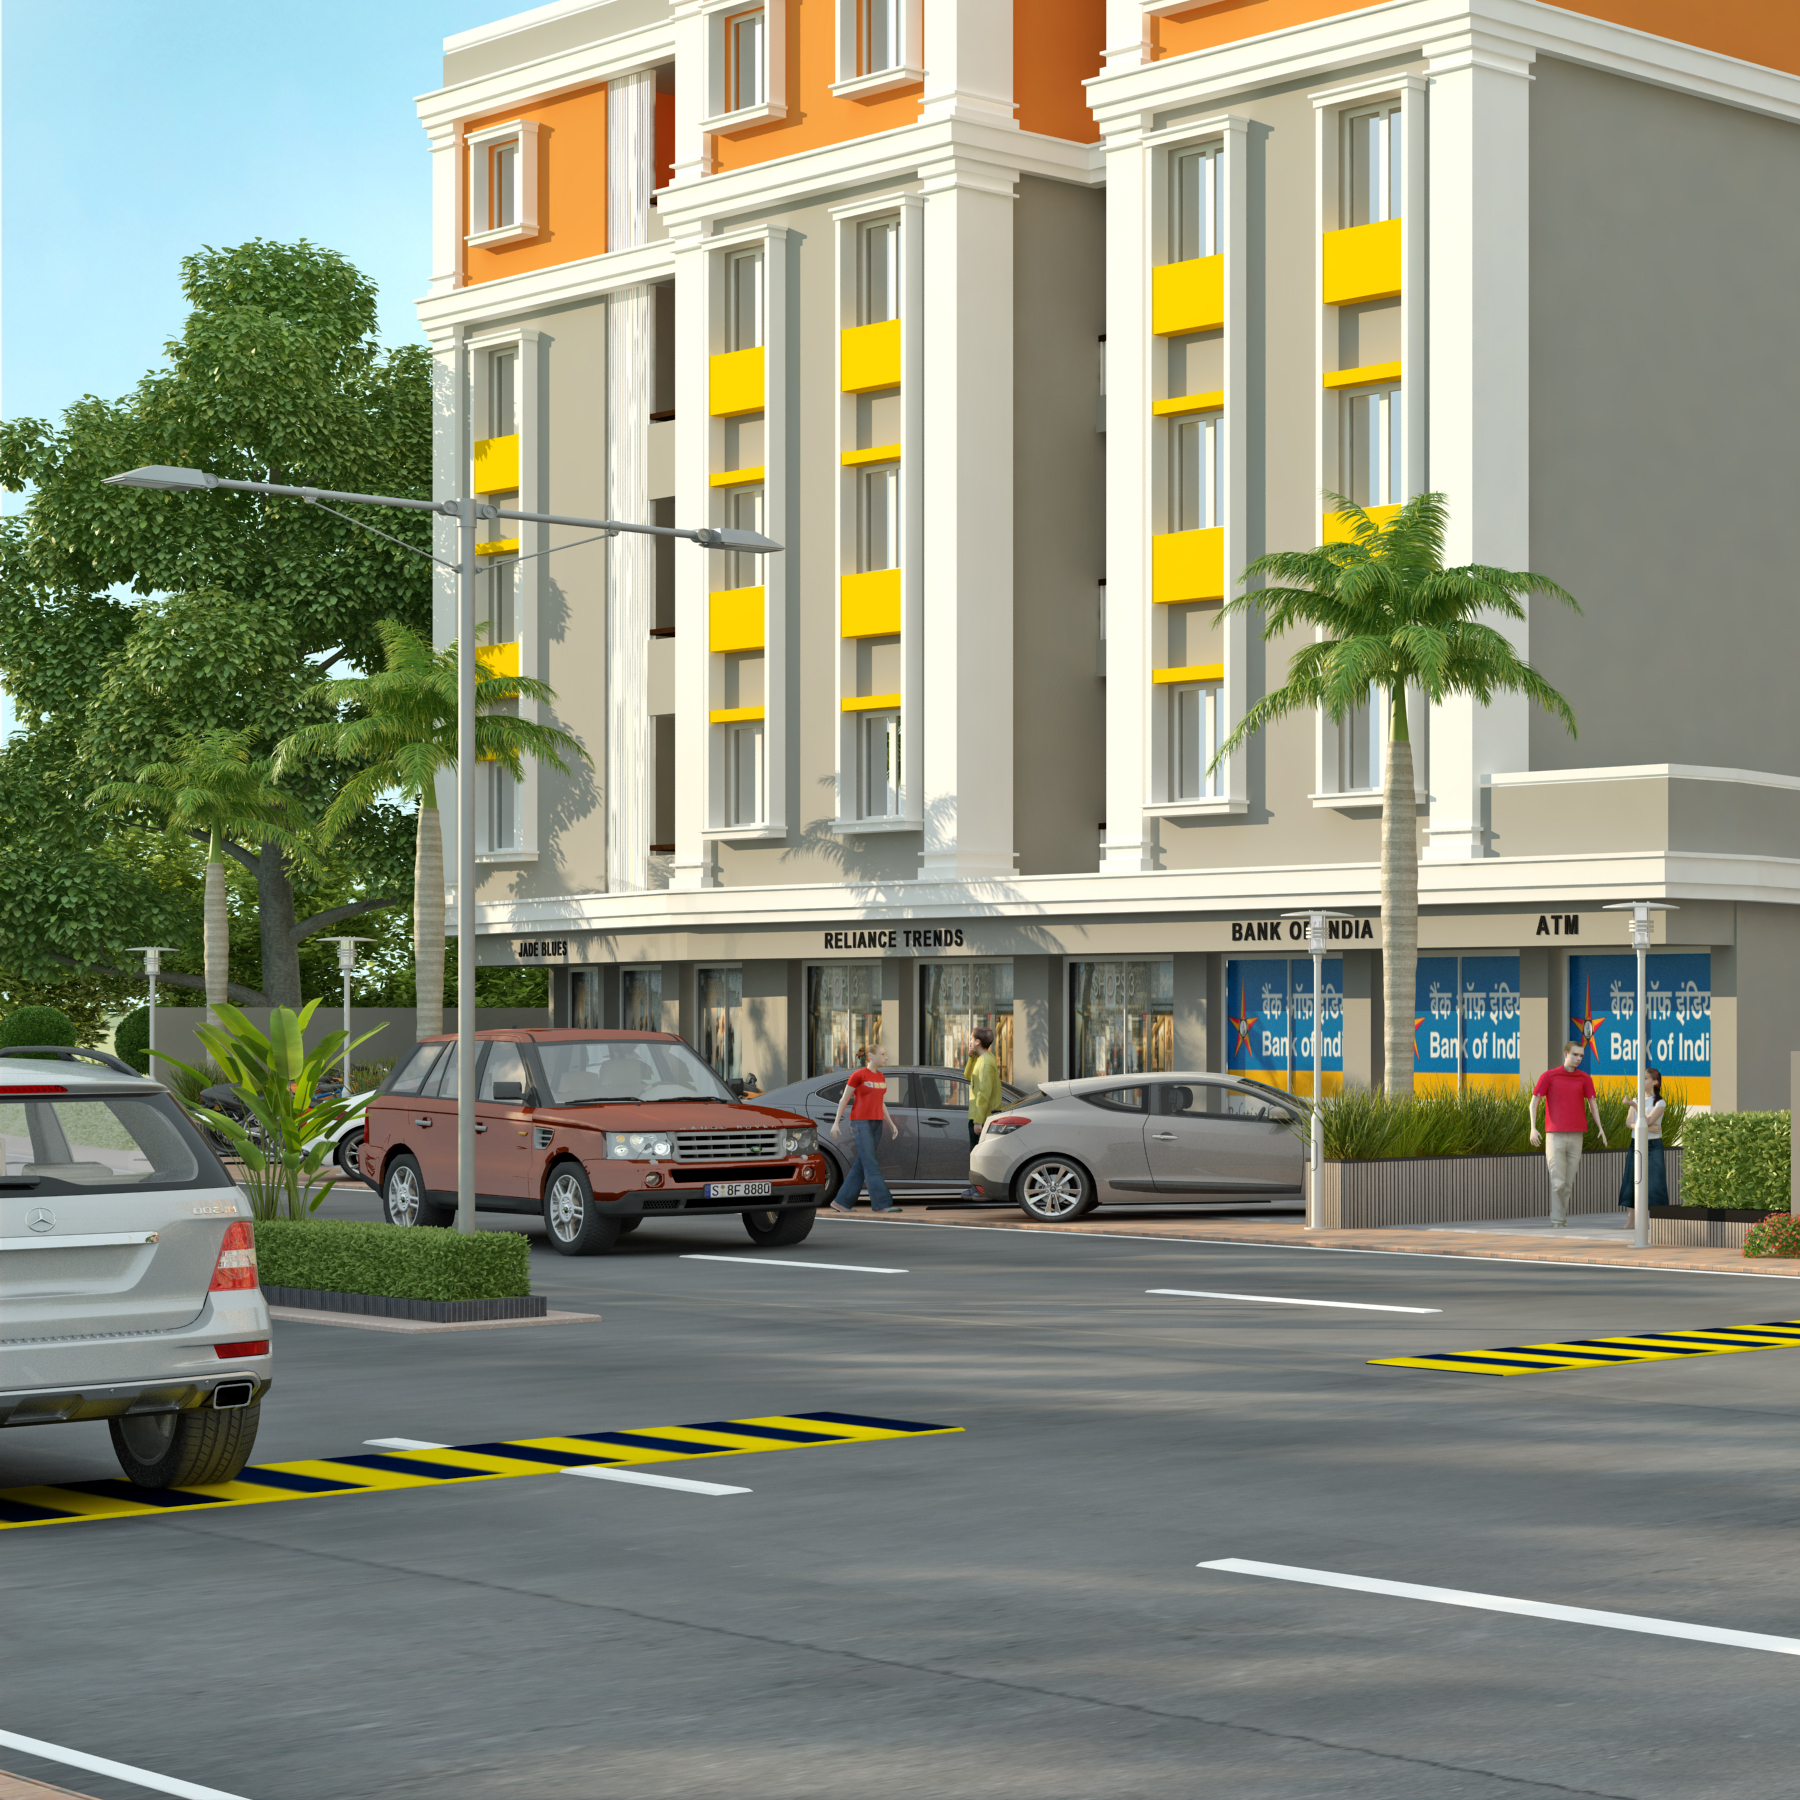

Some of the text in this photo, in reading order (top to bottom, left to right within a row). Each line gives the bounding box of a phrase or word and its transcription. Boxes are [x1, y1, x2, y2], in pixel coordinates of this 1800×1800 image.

[1231, 921, 1282, 941] BANK
[1328, 919, 1374, 940] NDIA
[1536, 914, 1579, 936] ATM
[518, 940, 568, 958] JADE BLUES
[824, 929, 964, 949] RELIANCE TRENDS
[1429, 981, 1452, 1020] बैंक
[1610, 980, 1635, 1020] बैंक
[1320, 1030, 1343, 1058] Ind
[1472, 1031, 1488, 1059] of
[1492, 1031, 1520, 1059] Indi
[1657, 1032, 1674, 1061] of
[1678, 1032, 1709, 1062] Indi
[712, 1185, 719, 1196] S
